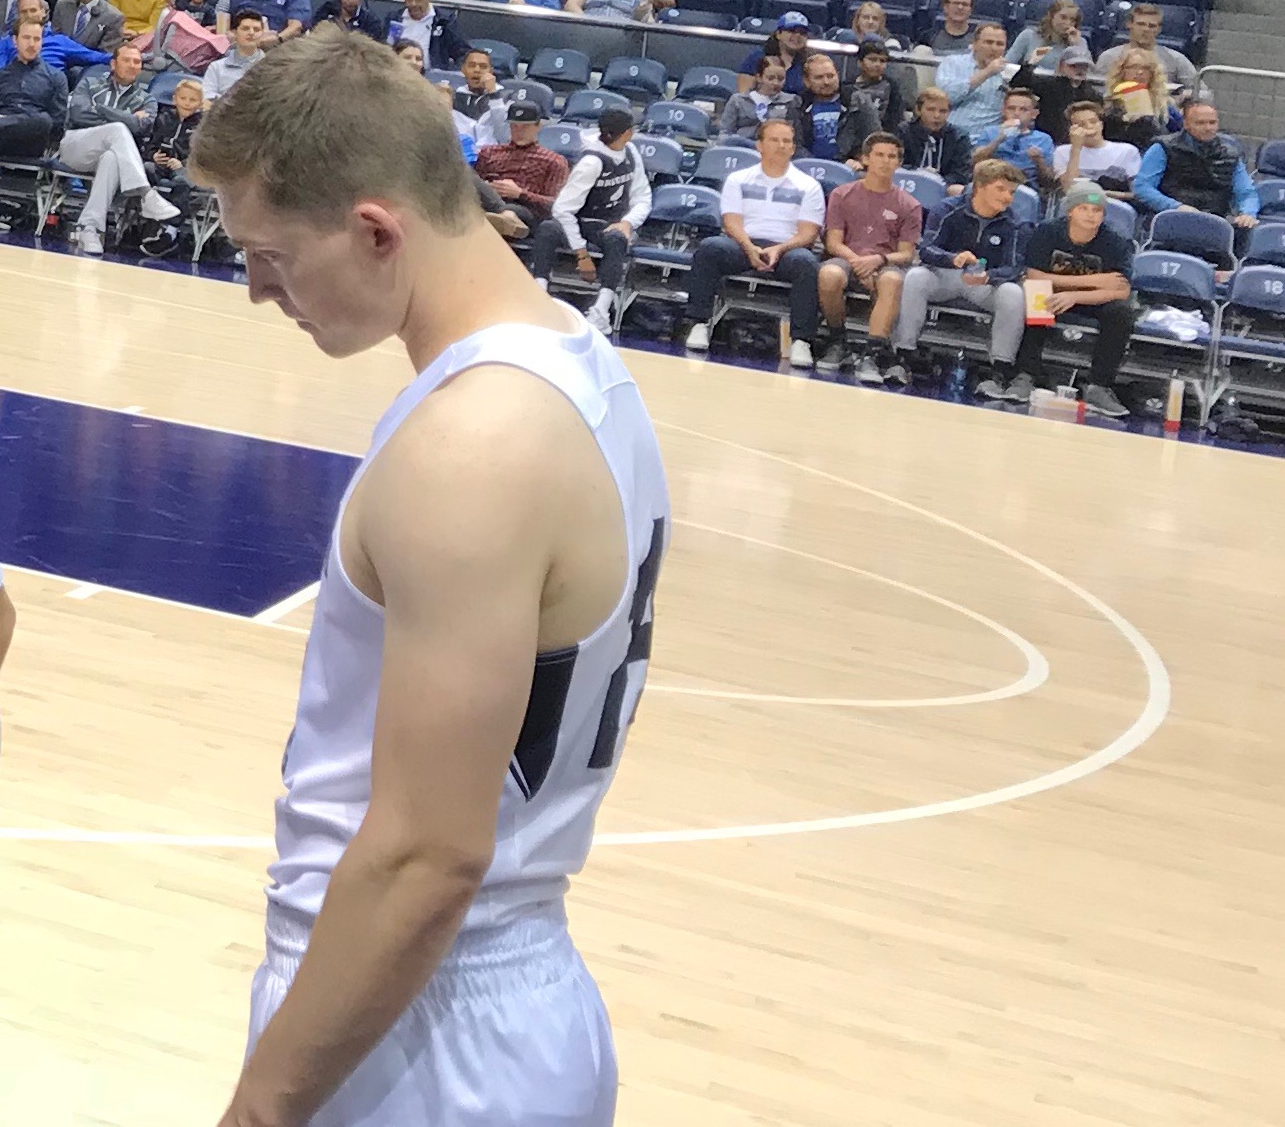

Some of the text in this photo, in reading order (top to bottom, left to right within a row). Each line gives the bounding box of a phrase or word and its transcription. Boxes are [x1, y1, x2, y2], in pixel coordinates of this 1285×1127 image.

[554, 56, 720, 86] 8 9 10
[517, 88, 685, 122] 8 9 10
[560, 132, 917, 193] 9 10 11 12 13
[680, 194, 698, 208] 12
[1160, 261, 1285, 296] 17 18
